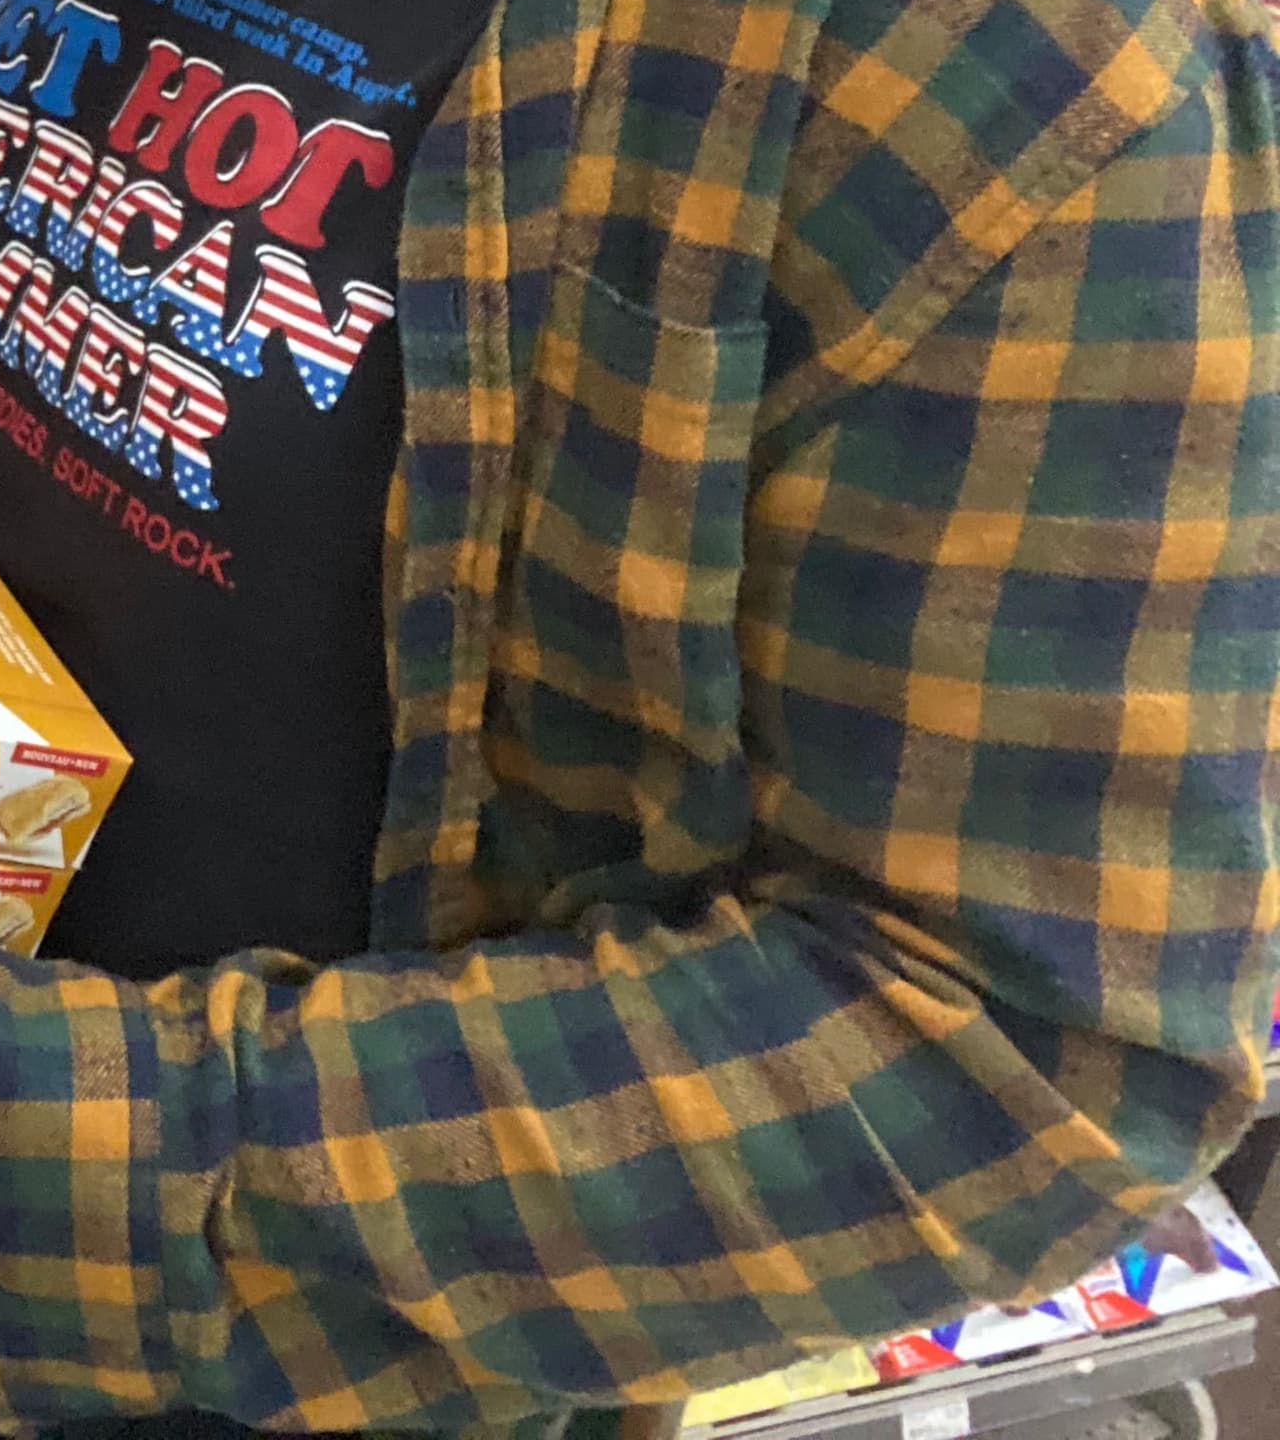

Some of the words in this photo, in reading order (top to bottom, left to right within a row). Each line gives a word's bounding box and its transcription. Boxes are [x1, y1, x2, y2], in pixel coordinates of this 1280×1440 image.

[108, 38, 395, 249] HOT
[51, 447, 122, 516] SOFT
[121, 498, 237, 589] ROCK.
